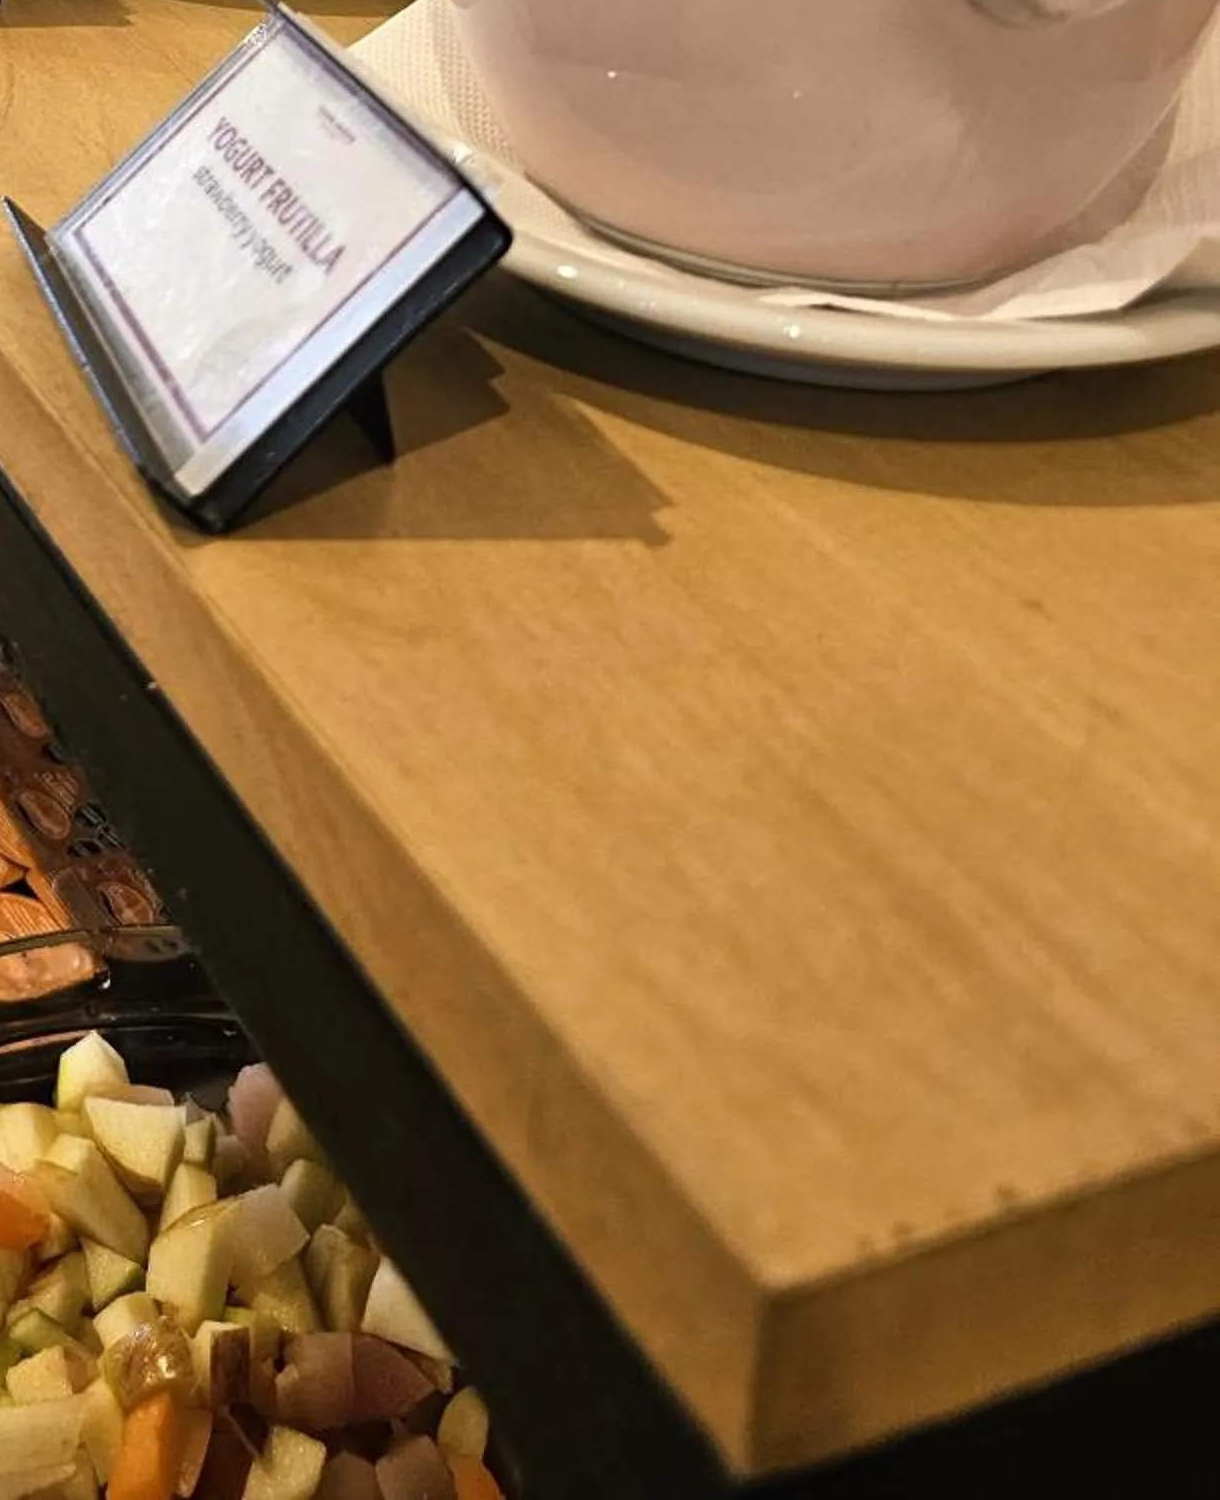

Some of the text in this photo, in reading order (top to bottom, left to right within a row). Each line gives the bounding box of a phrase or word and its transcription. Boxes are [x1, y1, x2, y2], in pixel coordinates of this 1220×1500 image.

[192, 165, 294, 285] strawberry yogurt
[207, 116, 276, 191] YOGURT
[259, 177, 347, 277] FRUTILLA
